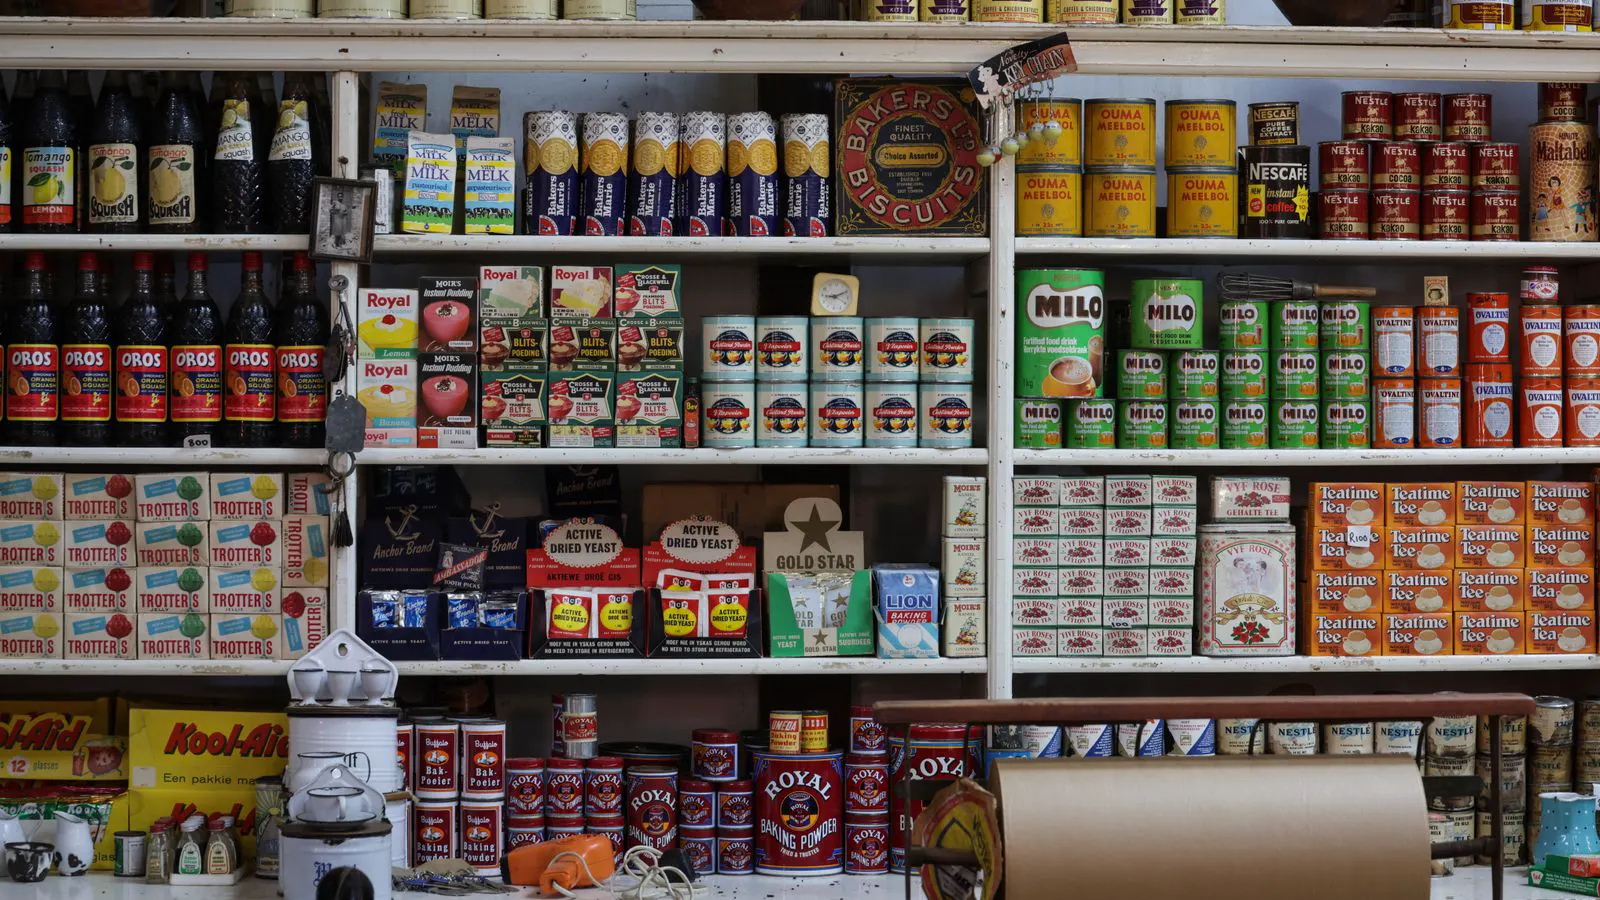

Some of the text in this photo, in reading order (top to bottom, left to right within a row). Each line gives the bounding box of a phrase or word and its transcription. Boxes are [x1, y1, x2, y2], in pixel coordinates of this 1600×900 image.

[1002, 48, 1067, 84] KEY CHAIN
[1354, 96, 1389, 106] NESTLÉ
[1101, 109, 1143, 120] OUMA
[1180, 110, 1222, 121] OUMA
[1253, 108, 1296, 120] NESCAFÉ
[380, 116, 418, 129] MILK
[453, 117, 494, 129] MELK
[847, 89, 975, 152] BAKERS LTD
[1097, 120, 1146, 131] MEELBOL
[1176, 121, 1225, 132] MEELBOL
[895, 124, 925, 133] FINEST
[1360, 124, 1384, 135] kakao
[889, 132, 933, 142] QUALITY
[224, 148, 250, 160] squash
[282, 147, 309, 159] squash
[883, 150, 939, 160] Choice Assorted
[1432, 146, 1467, 157] NESTLÉ
[29, 165, 65, 174] SQUASH
[411, 166, 451, 180] MILK
[1249, 162, 1308, 181] NESCAFÉ
[468, 170, 510, 182] MELK
[1438, 174, 1462, 184] kakao
[547, 176, 557, 217] Bakers
[697, 176, 708, 216] Bakers
[848, 165, 975, 224] BISCUITS
[1266, 188, 1295, 198] instant
[557, 182, 565, 217] Marie
[707, 182, 716, 217] Marie
[32, 205, 64, 214] LEMON
[91, 194, 134, 219] SQUASH
[1266, 201, 1295, 213] coffee
[483, 268, 517, 281] Royal
[555, 268, 589, 281] Royal
[635, 273, 661, 282] CROSSE
[637, 278, 670, 287] BLACKWELL
[424, 288, 474, 298] Instant Pudding
[367, 293, 411, 308] Royal
[1035, 295, 1102, 318] MILO
[1146, 304, 1194, 321] MILO
[1285, 309, 1318, 320] MILO
[513, 338, 538, 347] BLITS-
[12, 351, 52, 367] OROS
[176, 351, 217, 368] OROS
[280, 351, 319, 368] OROS
[382, 349, 411, 359] Lemon
[511, 349, 540, 358] POEDING
[421, 363, 473, 374] Instant Pudding
[1125, 358, 1162, 370] MILO
[364, 363, 409, 380] Royal
[1282, 408, 1318, 420] MILO
[1227, 481, 1281, 494] VYF ROSE
[1319, 486, 1379, 501] Teatime
[1531, 484, 1591, 499] Teatime
[1319, 500, 1346, 514] Tea
[1531, 498, 1557, 512] Tee
[1226, 509, 1264, 517] GEHALTE
[565, 529, 603, 540] ACTIVE
[682, 524, 720, 536] ACTIVE
[373, 538, 434, 560] Anchor Brand
[491, 537, 519, 554] Brand
[550, 543, 618, 554] DRIED YEAST
[666, 537, 734, 550] DRIED YEAST
[1226, 544, 1274, 557] VYF ROSE
[776, 554, 856, 570] GOLD STAR
[886, 594, 932, 608] LION
[561, 608, 582, 616] ACTIVE
[890, 611, 928, 620] BAKING
[1315, 615, 1377, 630] Teatime
[1531, 613, 1592, 628] Teatime
[1315, 629, 1342, 644] Tee
[1531, 627, 1558, 641] Tea
[777, 640, 798, 648] YEAST
[1278, 726, 1317, 738] NESTLÉ
[1435, 726, 1475, 738] NESTLÉ
[11, 759, 59, 774] 12 glasses
[425, 766, 448, 775] Bak-
[163, 773, 232, 786] Een pakkie
[420, 776, 451, 785] Poeier
[511, 775, 542, 789] ROYAL
[851, 769, 885, 785] ROYAL
[764, 769, 832, 801] ROYAL
[631, 789, 677, 812] ROYAL
[761, 818, 838, 851] BAKING POWDER
[463, 841, 495, 853] Baking
[463, 852, 495, 862] Powder
